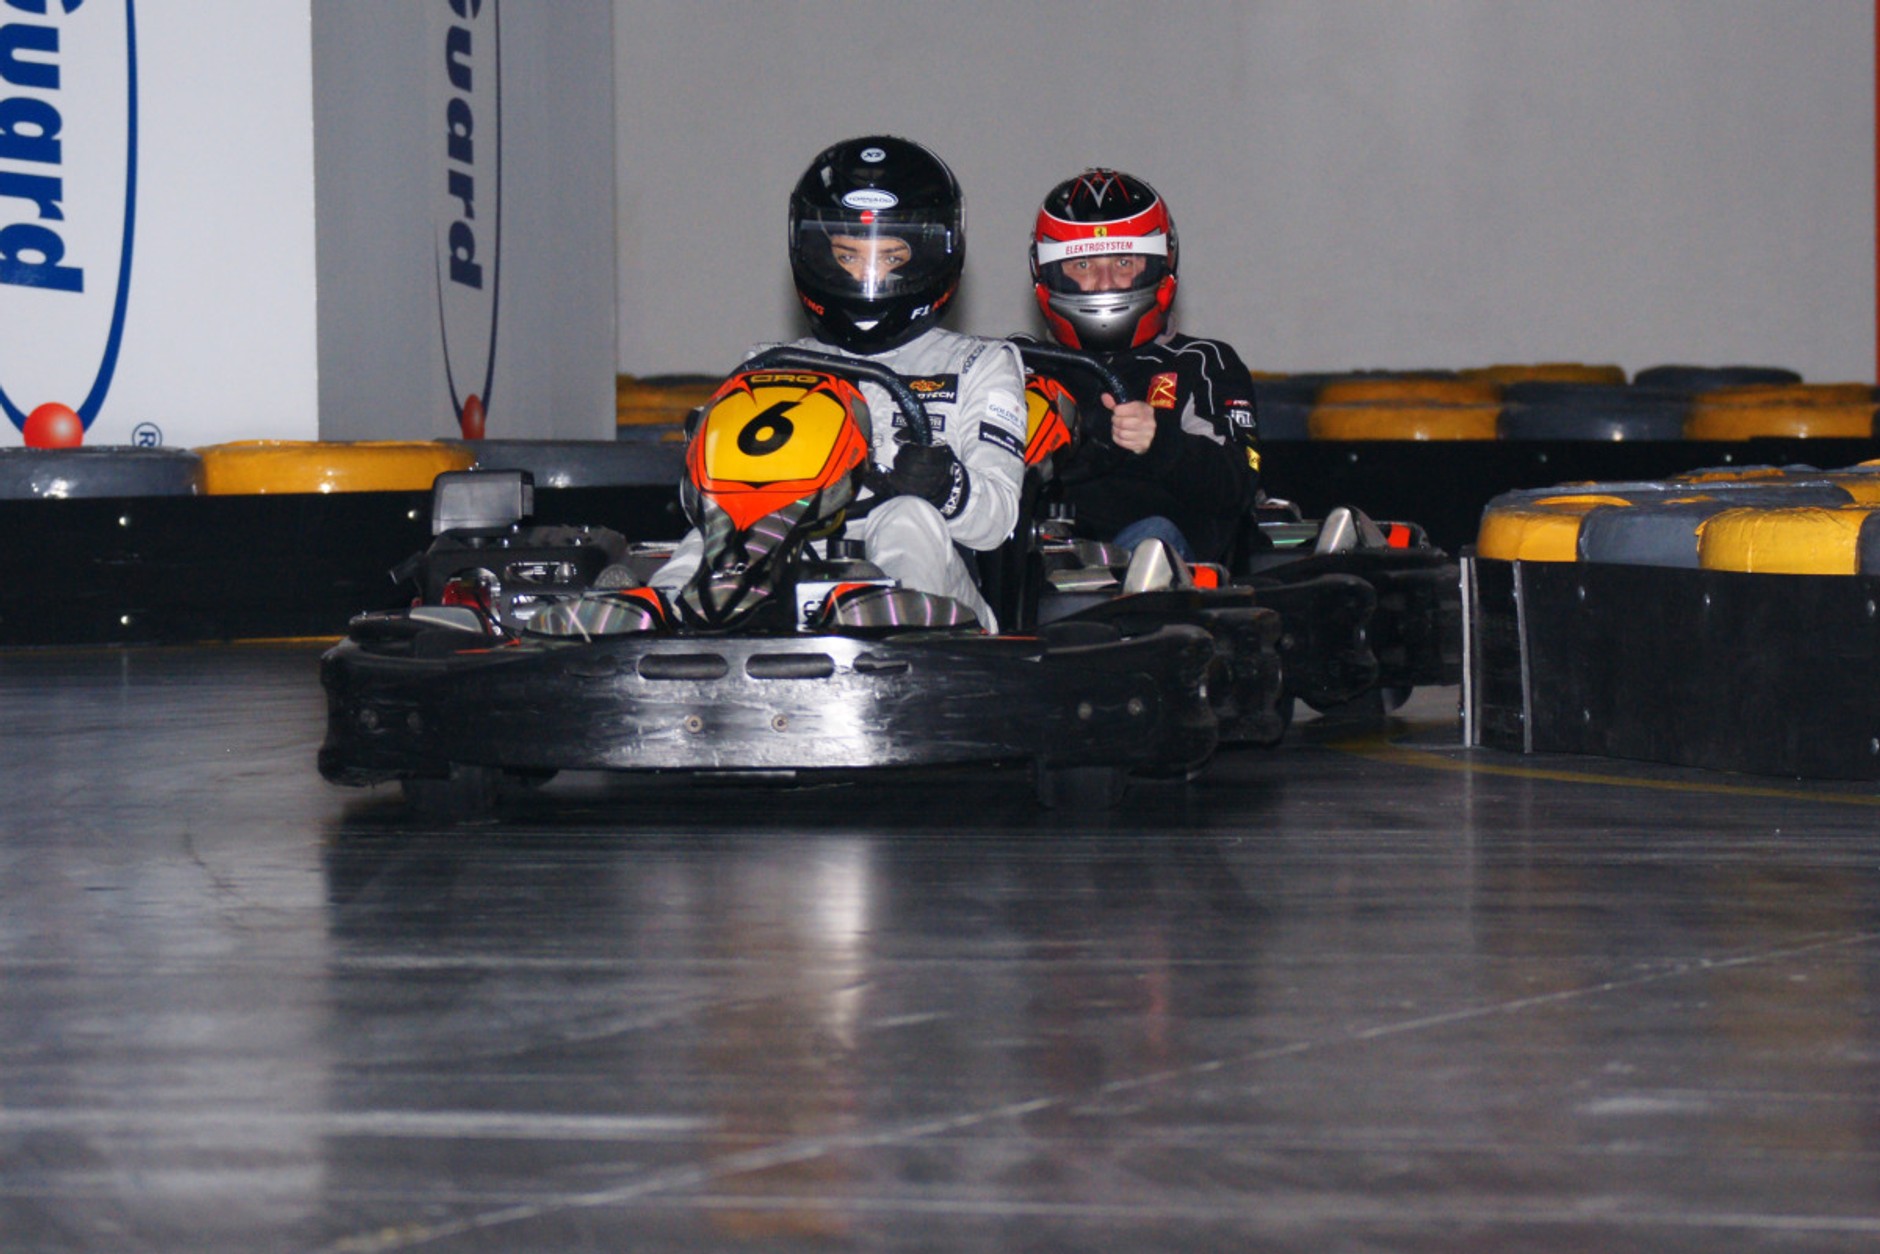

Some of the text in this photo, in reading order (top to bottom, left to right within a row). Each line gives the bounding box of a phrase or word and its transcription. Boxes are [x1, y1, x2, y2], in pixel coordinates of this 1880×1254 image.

[0, 0, 84, 293] uard
[445, 0, 483, 290] uard
[1066, 241, 1133, 255] ELEKTROSYSTEM
[737, 401, 803, 457] 6
